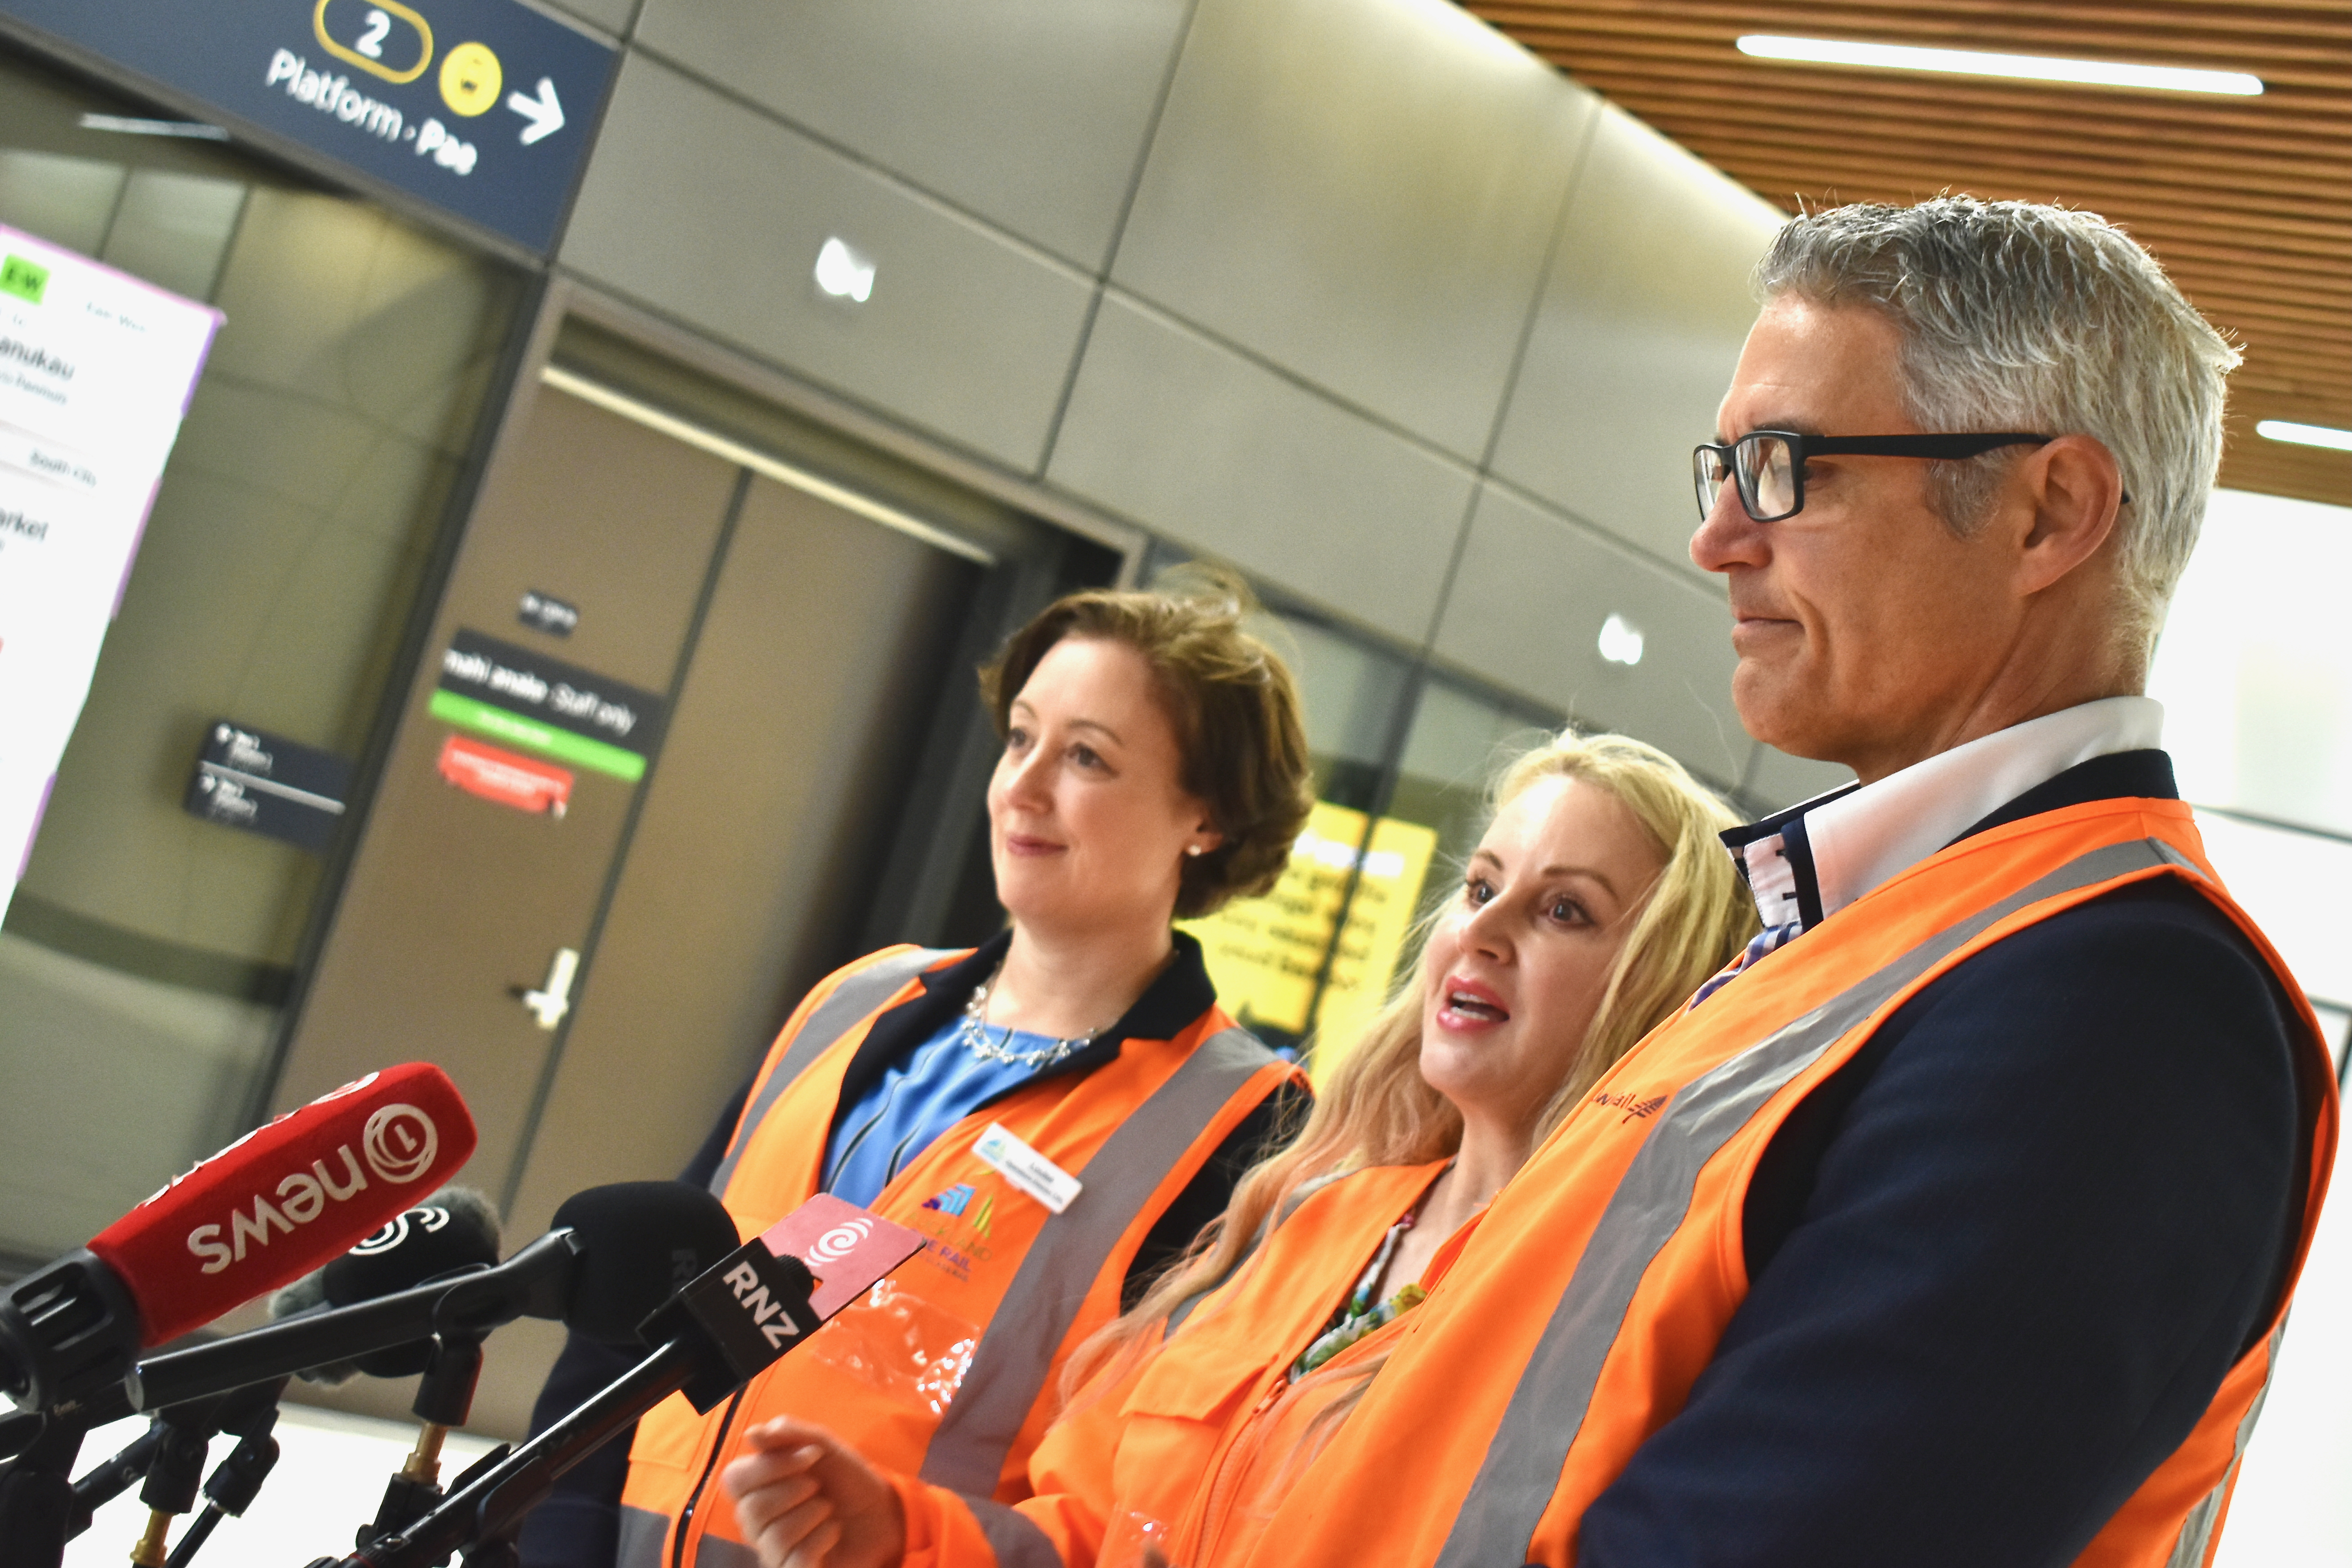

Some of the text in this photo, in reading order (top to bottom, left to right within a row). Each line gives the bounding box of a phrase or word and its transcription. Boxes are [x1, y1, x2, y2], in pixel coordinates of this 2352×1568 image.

[355, 9, 391, 59] 2
[266, 47, 479, 176] Platform Pae
[593, 701, 637, 738] only
[187, 1144, 369, 1274] news
[939, 1244, 973, 1273] RAIL
[722, 1261, 800, 1350] RNZ
